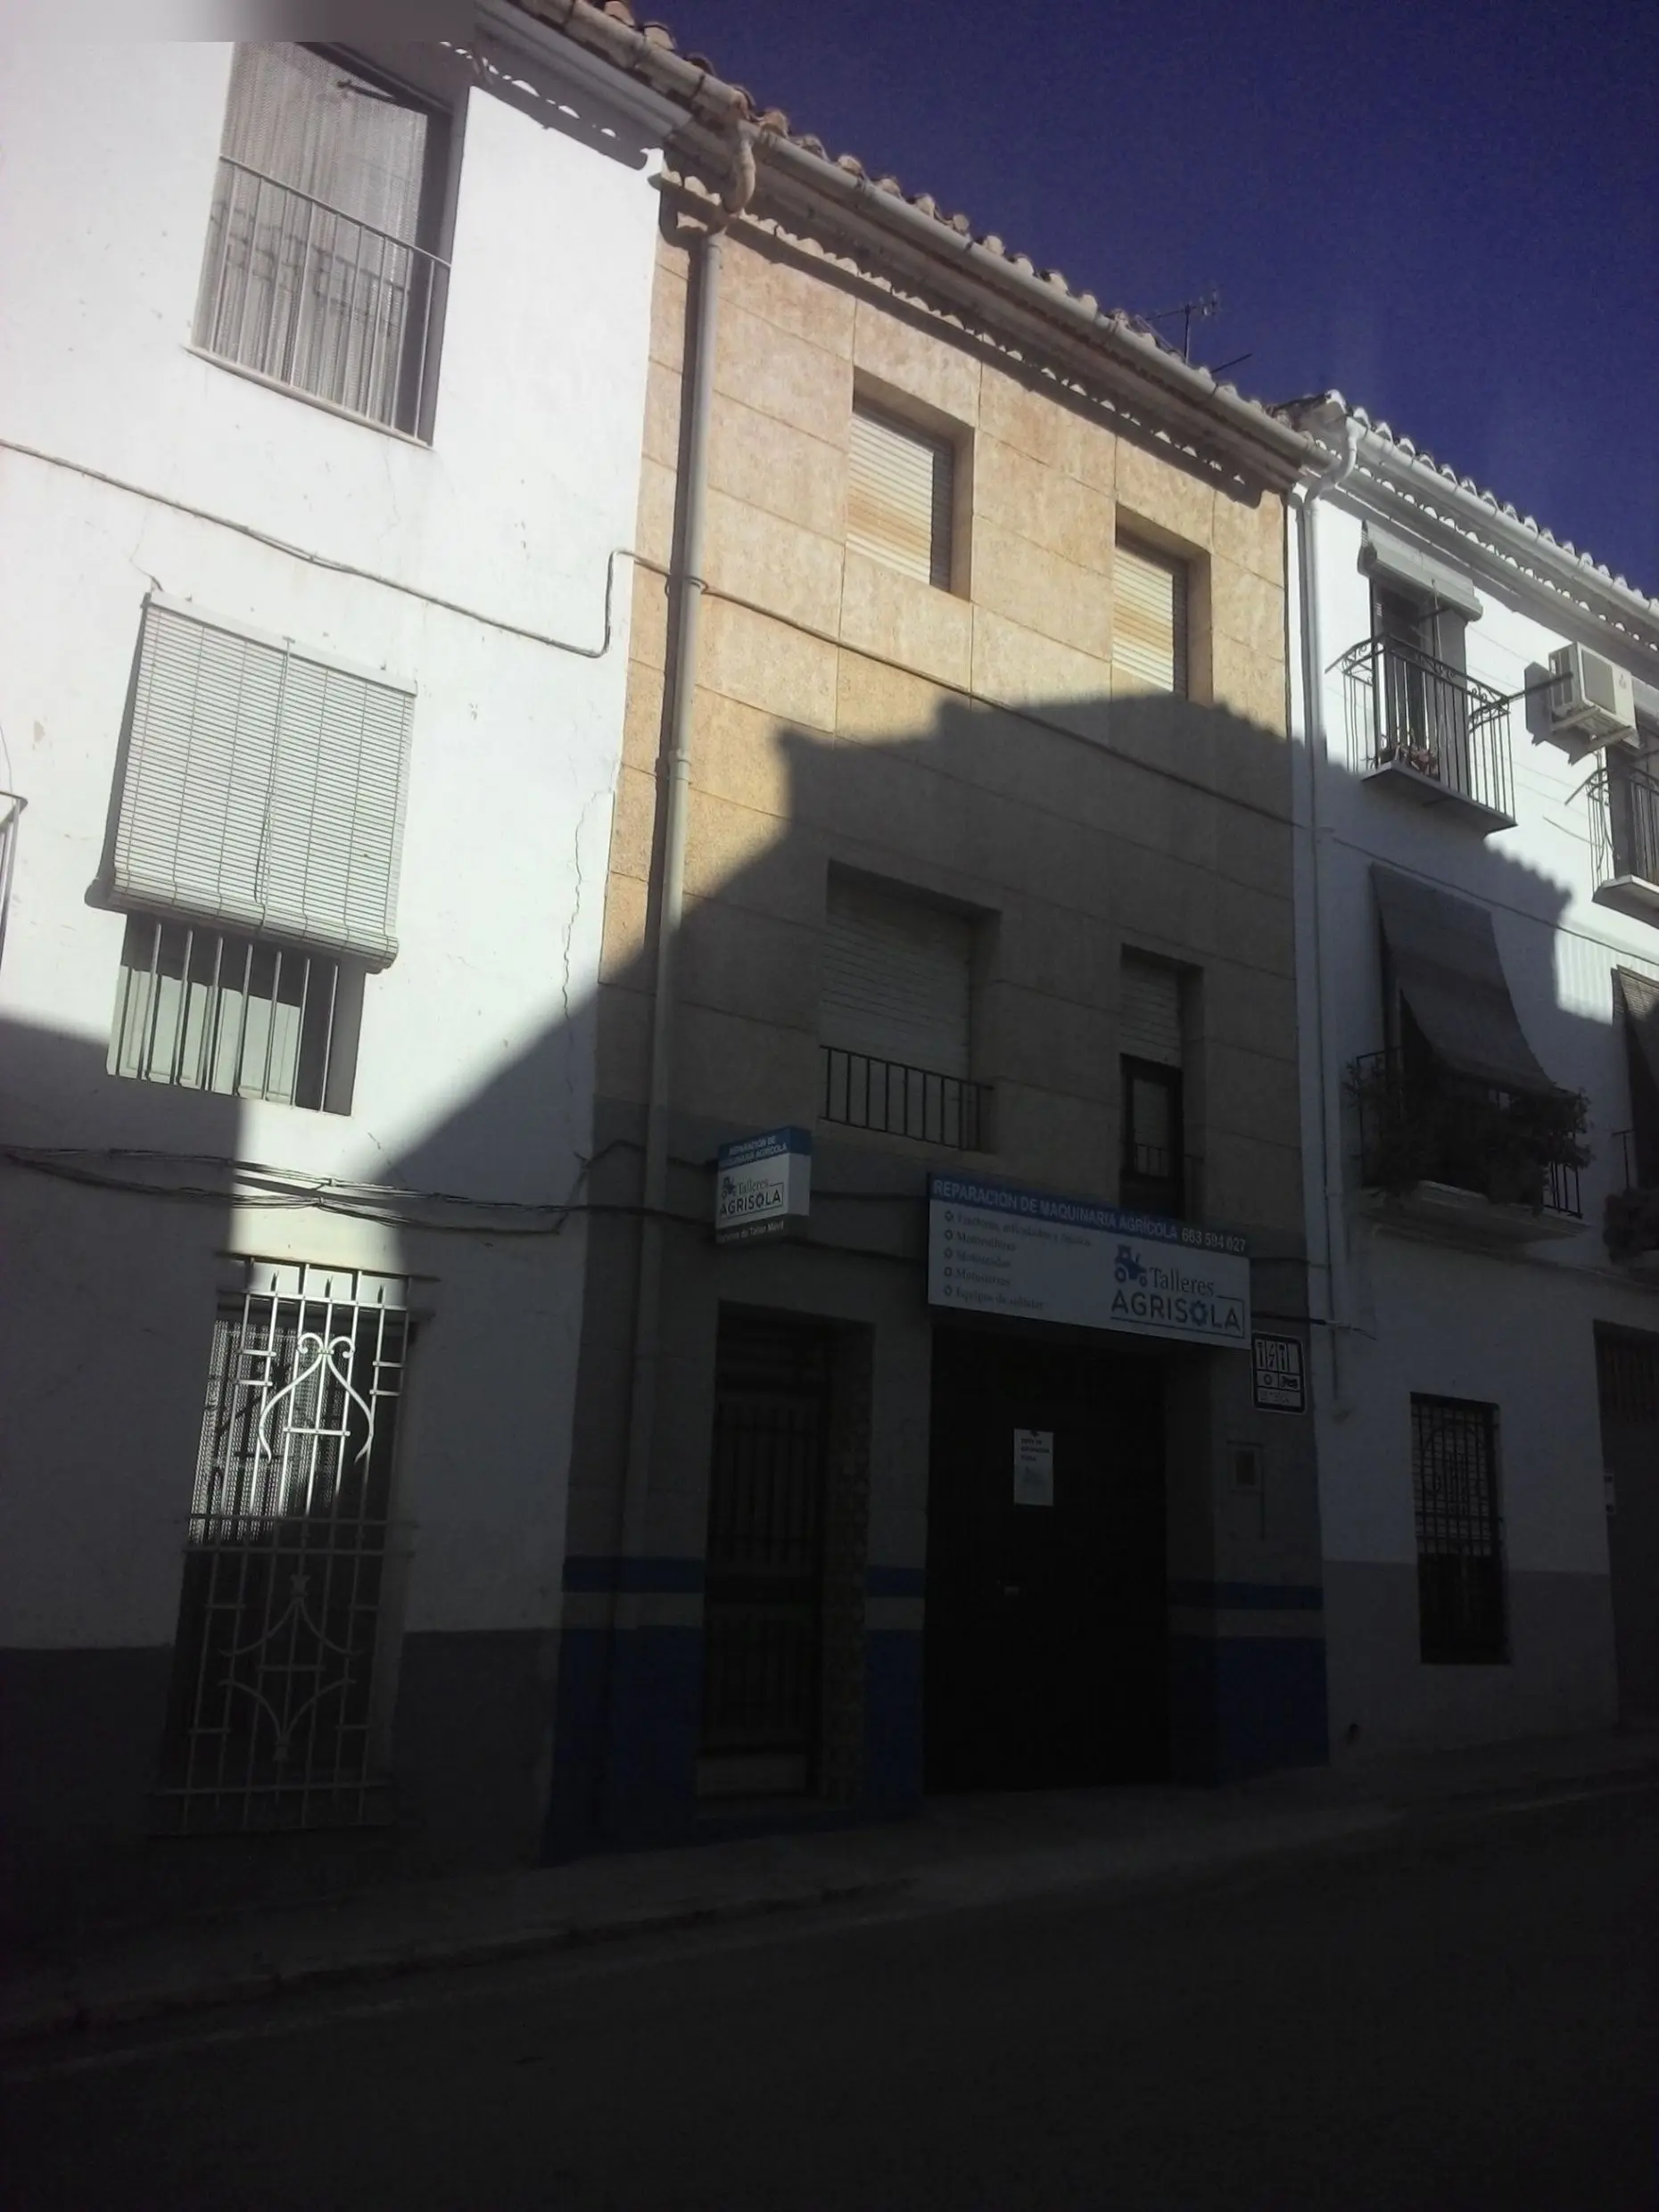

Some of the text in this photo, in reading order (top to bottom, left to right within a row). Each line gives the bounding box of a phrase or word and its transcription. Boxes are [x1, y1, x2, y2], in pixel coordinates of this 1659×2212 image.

[739, 1177, 771, 1195] Talleres
[720, 1189, 782, 1217] AGRISOLA
[1019, 1195, 1039, 1214] DE
[1039, 1200, 1117, 1230] MAQUINARIA
[1181, 1227, 1202, 1247] 663
[1204, 1232, 1226, 1250] 594
[1226, 1235, 1247, 1253] 027
[1149, 1267, 1215, 1298] Talleres
[1111, 1290, 1242, 1332] AGRISOLA
